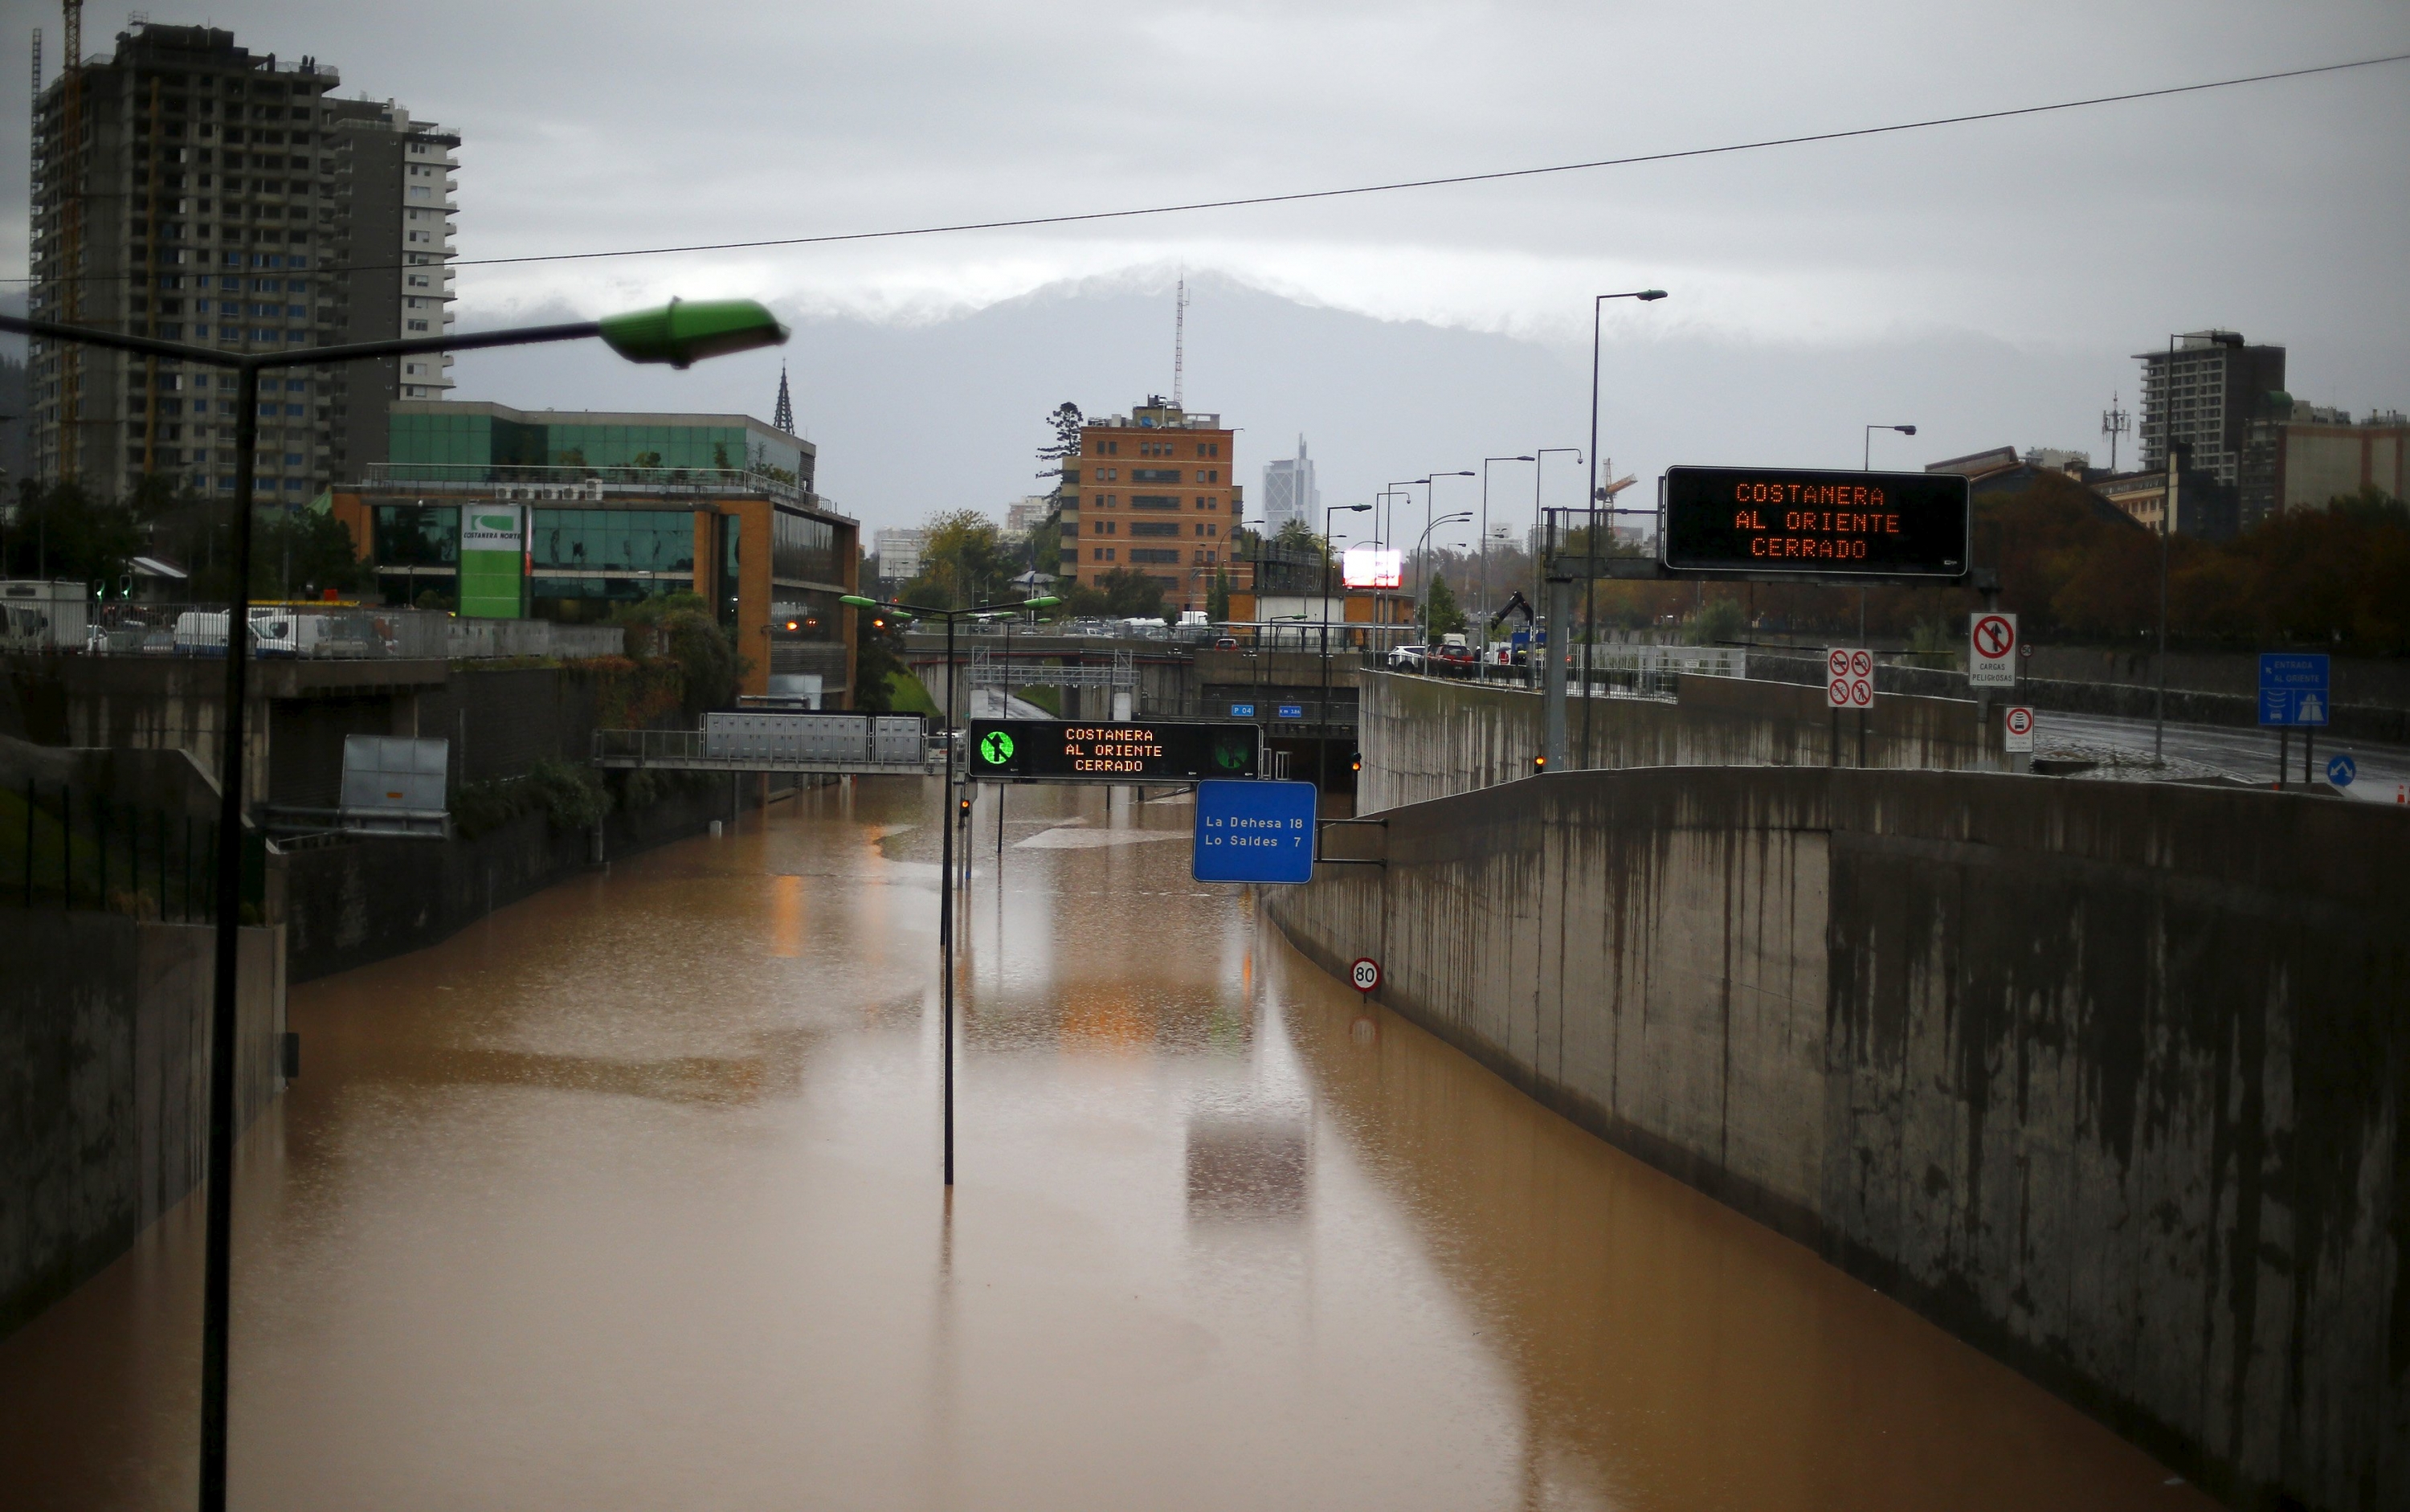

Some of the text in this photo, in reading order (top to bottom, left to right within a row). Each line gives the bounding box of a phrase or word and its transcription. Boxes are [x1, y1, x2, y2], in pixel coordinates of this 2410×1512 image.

[1736, 484, 1885, 505] COSTANERA
[1736, 510, 1900, 533] AL ORIENTE
[1752, 537, 1866, 558] CERRADO
[2022, 646, 2032, 654] 50
[2274, 660, 2313, 669] ENTRADA
[2274, 674, 2320, 683] AL ORIENTE
[1066, 729, 1153, 741] COSTANERA
[1066, 744, 1162, 757] AL ORIENTE
[1076, 760, 1142, 771] CERRADO
[1207, 816, 1302, 828] La Dehesa 18
[1206, 835, 1301, 847] Lo Saldes 7
[1356, 966, 1375, 983] 80
